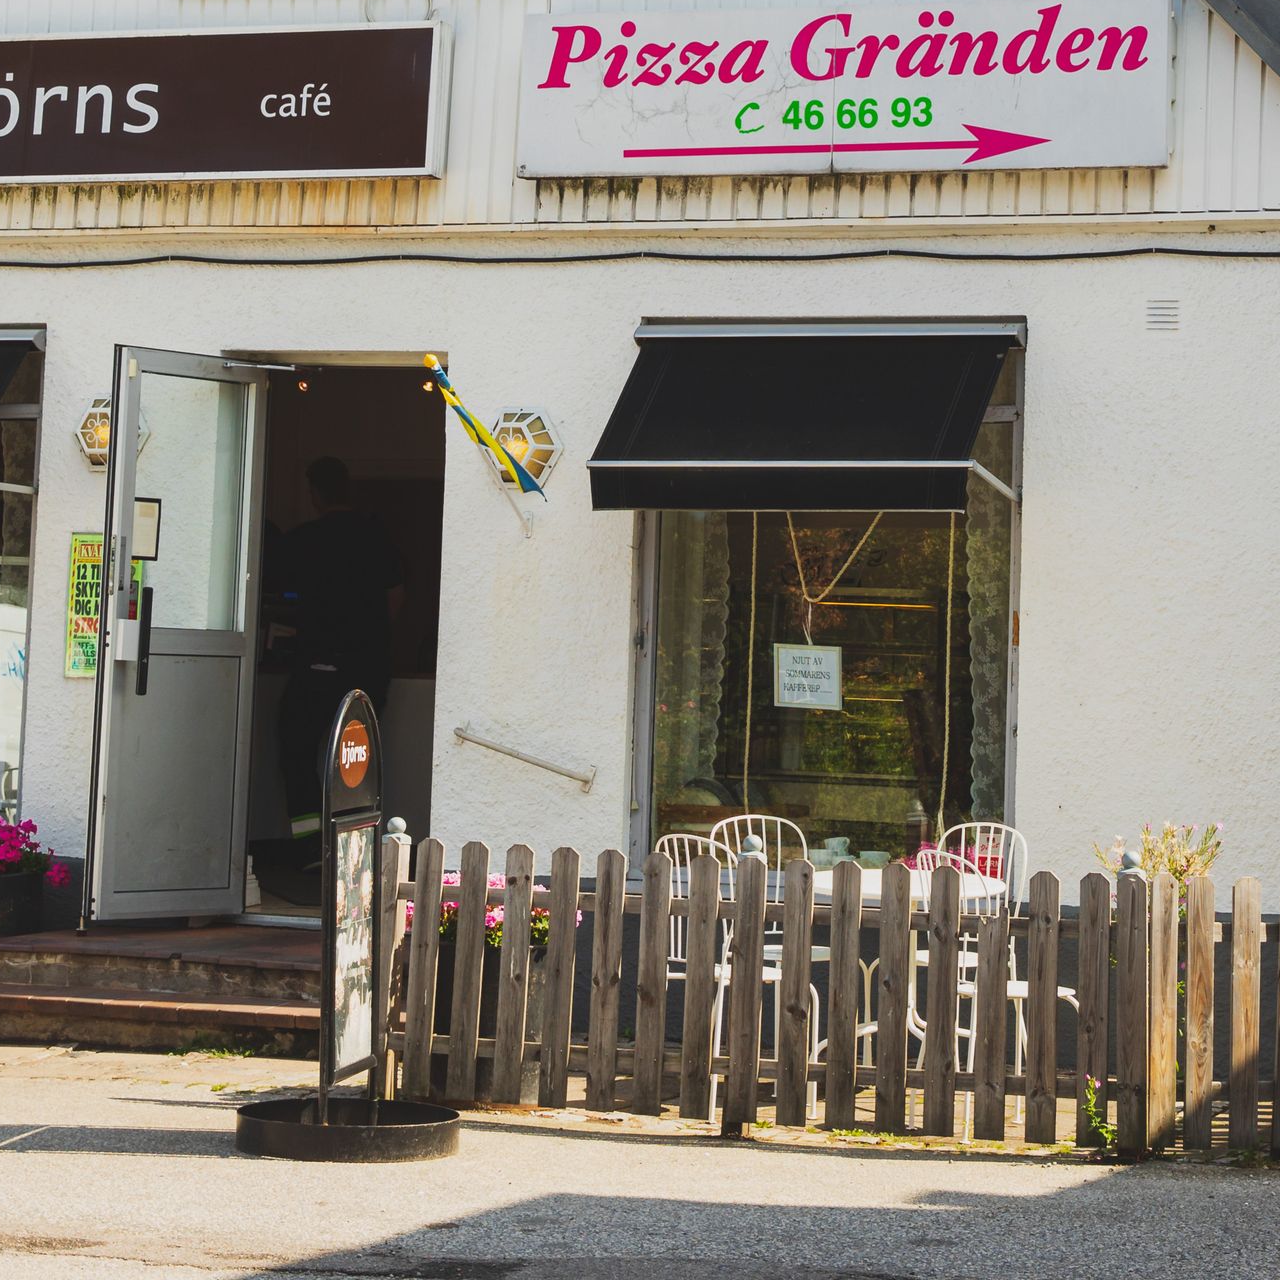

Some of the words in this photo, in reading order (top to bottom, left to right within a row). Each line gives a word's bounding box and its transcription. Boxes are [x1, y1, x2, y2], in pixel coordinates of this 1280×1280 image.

[538, 21, 769, 89] Pizza
[790, 4, 1149, 82] Gränden
[260, 83, 332, 118] café
[781, 99, 825, 132] 46
[835, 98, 879, 130] 66
[890, 96, 933, 128] 93
[76, 563, 88, 580] 12
[91, 564, 102, 580] TI
[75, 599, 91, 615] DIG
[792, 656, 811, 665] NJUT
[812, 657, 823, 666] AV
[341, 740, 367, 769] björns
